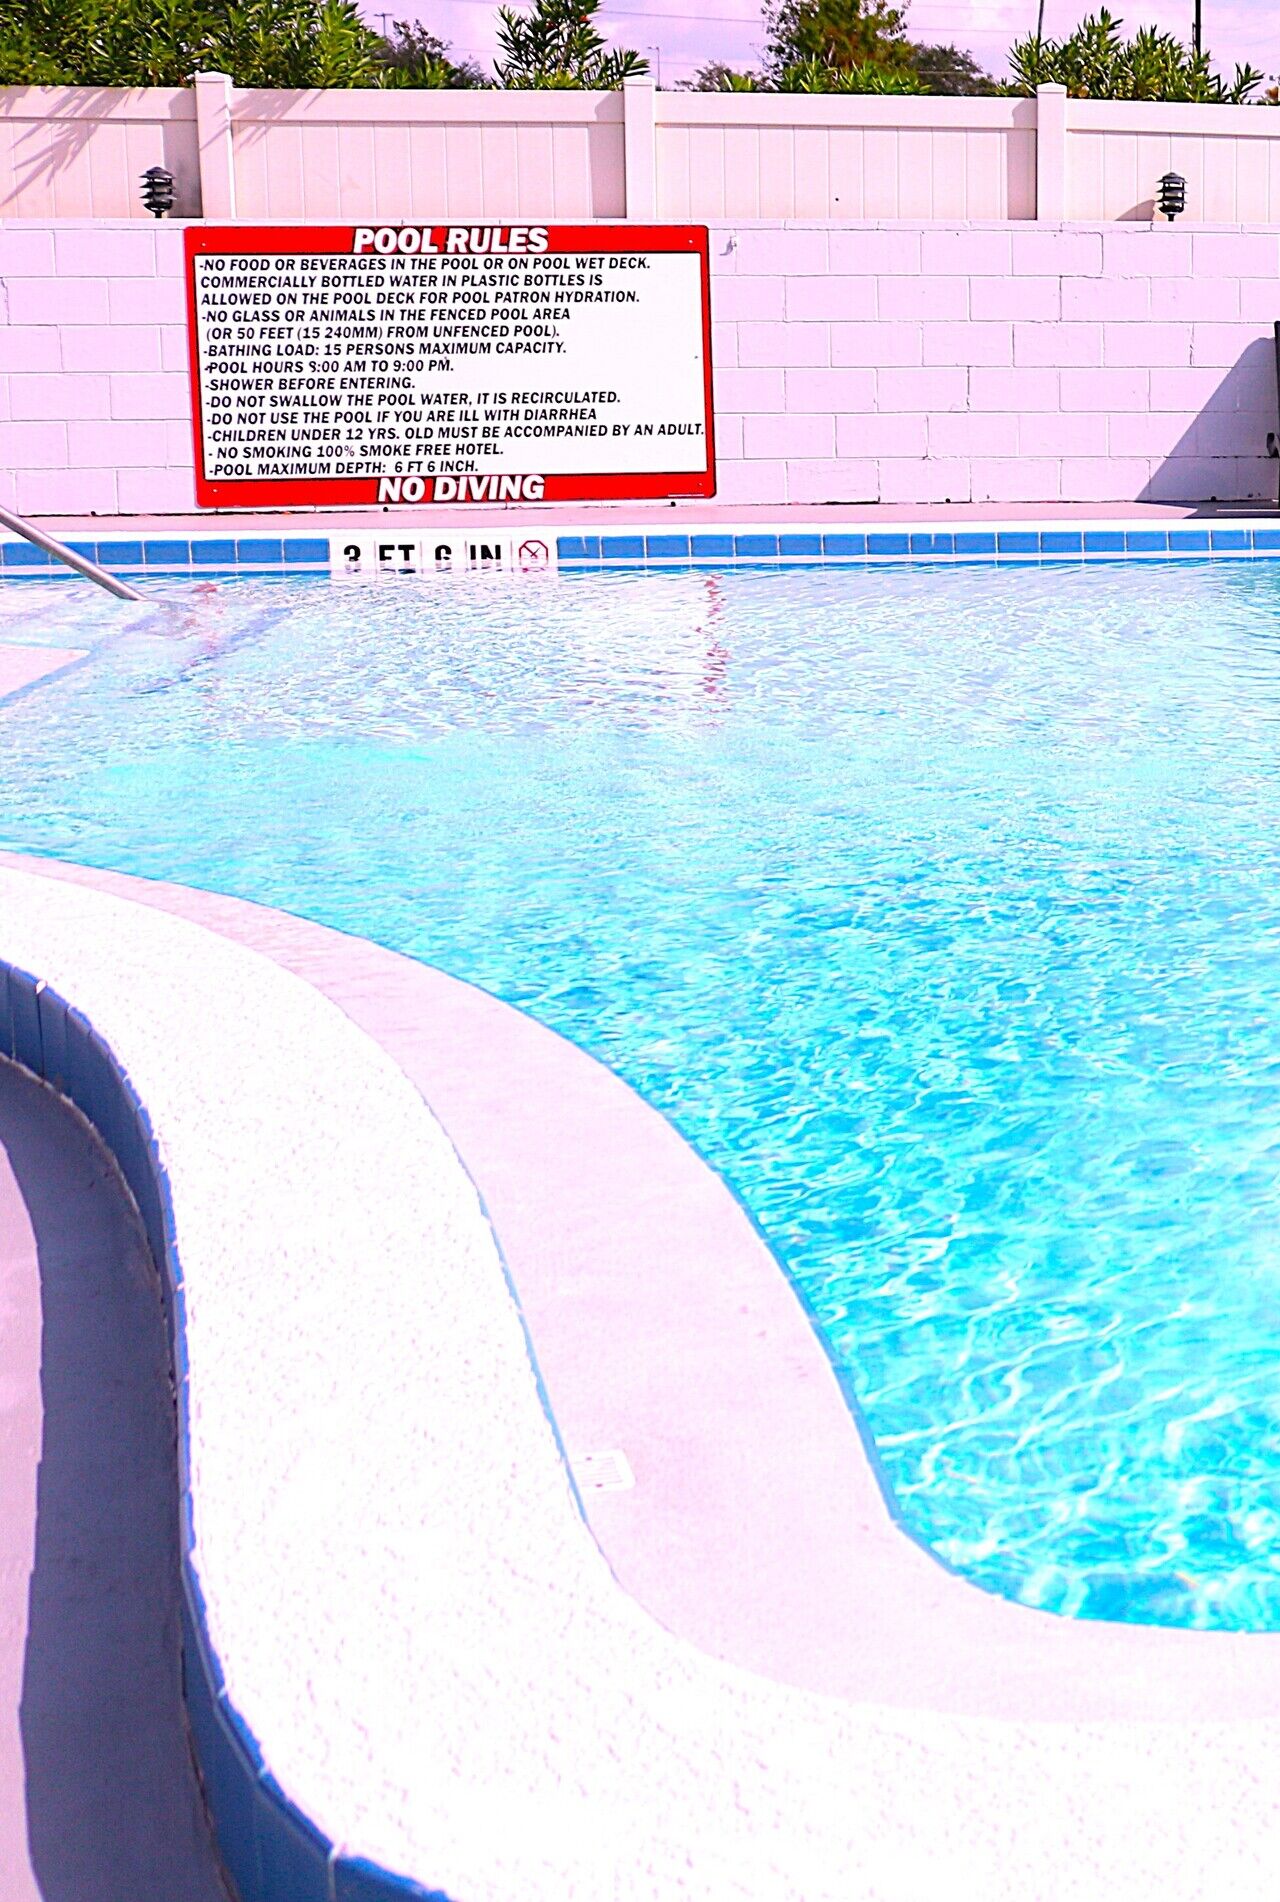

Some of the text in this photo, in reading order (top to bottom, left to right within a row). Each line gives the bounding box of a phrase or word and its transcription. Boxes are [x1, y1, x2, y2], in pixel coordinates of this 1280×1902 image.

[353, 227, 549, 254] POOL RULES
[199, 256, 650, 271] -NO FOOD OR BEVERAGES IN THE POOL OR ON POOL WET DECK.
[200, 273, 603, 288] COMMERCIALLY BOTTLED WATER IN PLASTIC BOTTLES IS
[200, 290, 640, 305] ALLOWED ON THE POOL DECK FOR POOL PATRON HYDRATION.
[201, 307, 571, 323] -NO GLASS OR ANIMALS IN THE FENCED POOL AREA
[206, 324, 560, 341] (OR 50 FEET (15 240MM) FROM UNFENCED POOL).
[203, 341, 566, 357] -BATHING LOAD: 15 PERSONS MAXIMUM CAPACITY.
[203, 361, 248, 374] -POOL
[251, 360, 304, 373] HOURS
[343, 360, 367, 372] AM
[370, 359, 389, 372] TO
[392, 359, 424, 372] 9:00
[427, 358, 454, 371] PM.
[204, 376, 415, 391] -SHOWER BEFORE ENTERING.
[205, 391, 621, 408] -DO NOT SWALLOW THE POOL WATER, IT IS RECIRCULATED.
[206, 408, 597, 425] -DO NOT USE THE POOL IF YOU ARE ILL WITH DIARRHEA
[207, 422, 704, 442] -CHILDREN UNDER 12 YRS. OLD MUST BE ACCOMPANIED BY AN ADULT.
[216, 446, 238, 459] NO
[242, 445, 312, 459] SMOKING
[316, 445, 355, 458] 100%
[359, 444, 412, 457] SMOKE
[415, 443, 452, 456] FREE
[454, 442, 504, 455] HOTEL.
[208, 459, 478, 476] -POOL MAXIMUM DEPTH: 6 FT 6 INCH.
[378, 475, 546, 502] NO DIVING
